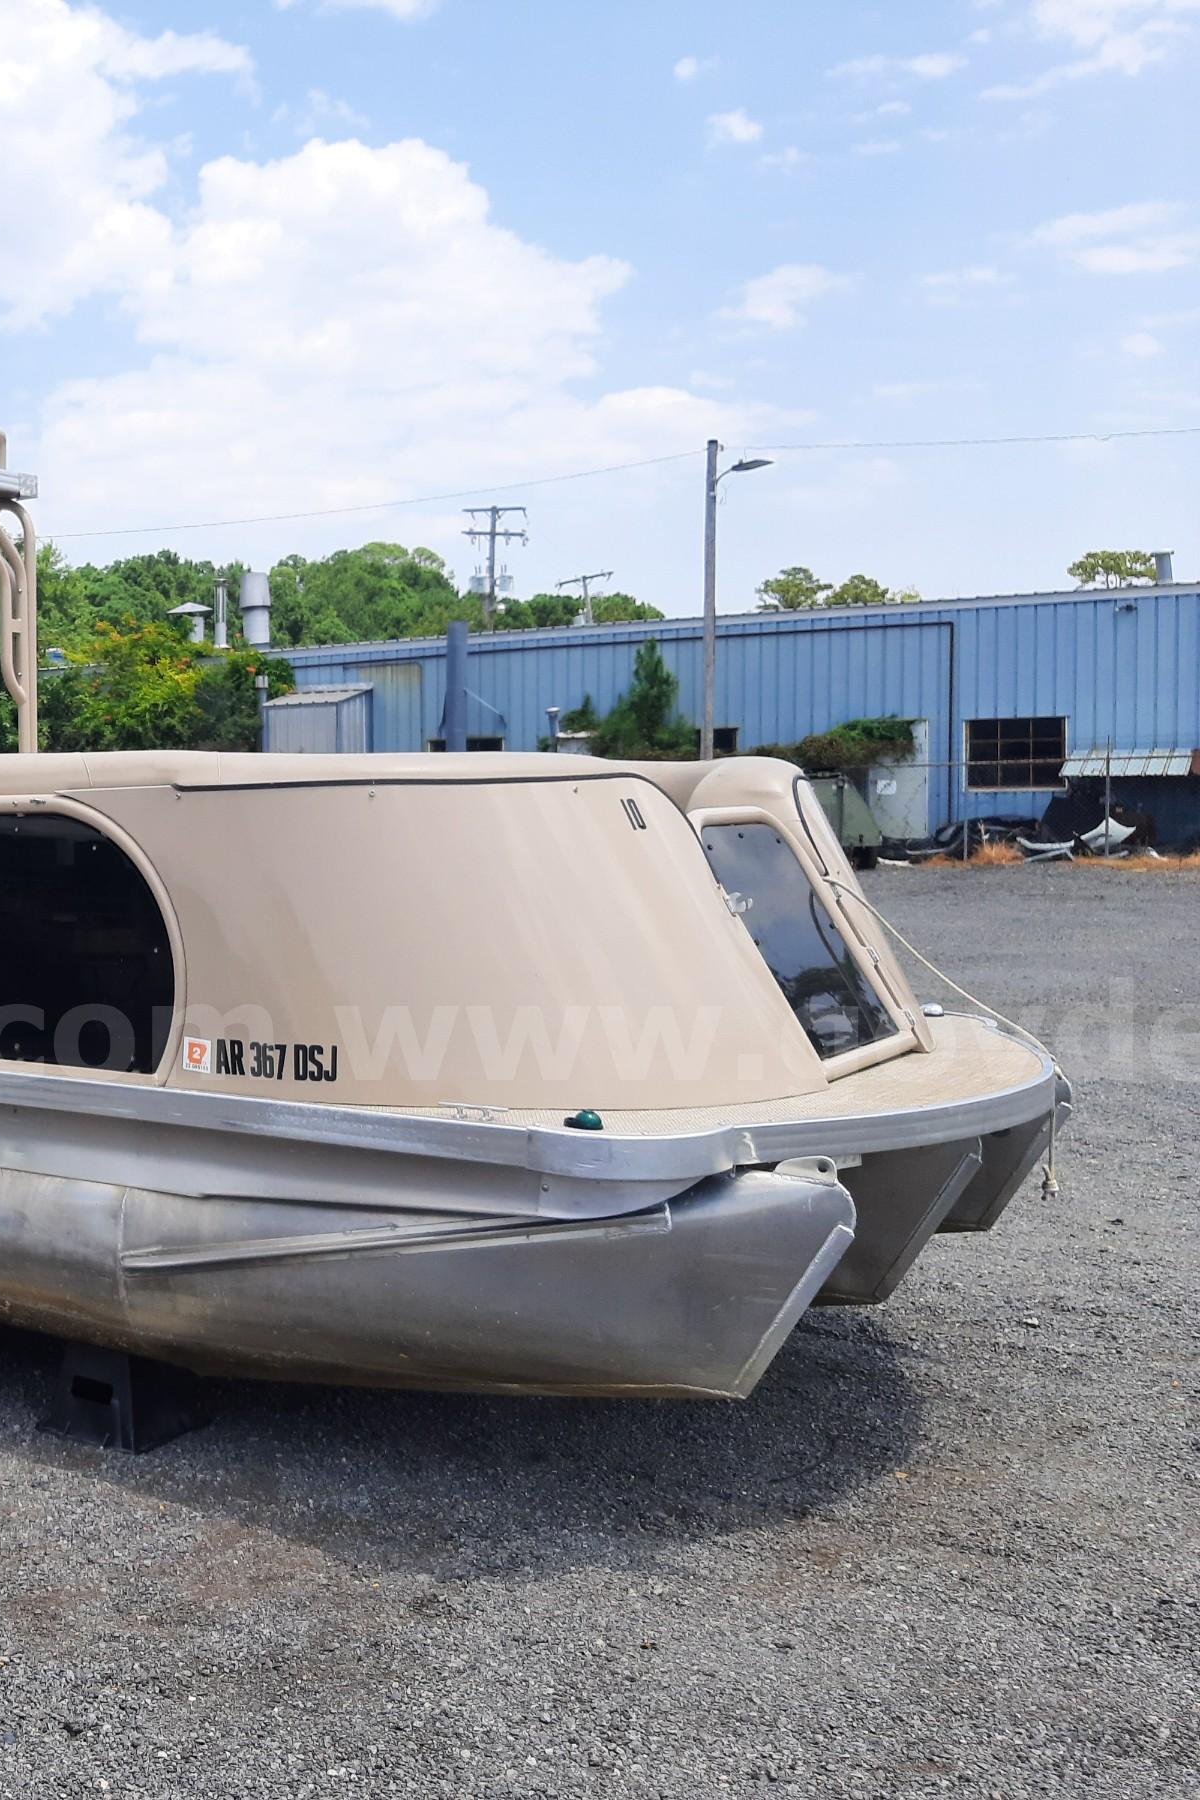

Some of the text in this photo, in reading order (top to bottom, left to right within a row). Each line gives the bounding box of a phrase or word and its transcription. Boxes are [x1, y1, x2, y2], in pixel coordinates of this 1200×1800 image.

[216, 1038, 338, 1082] AR 367 DSJ
